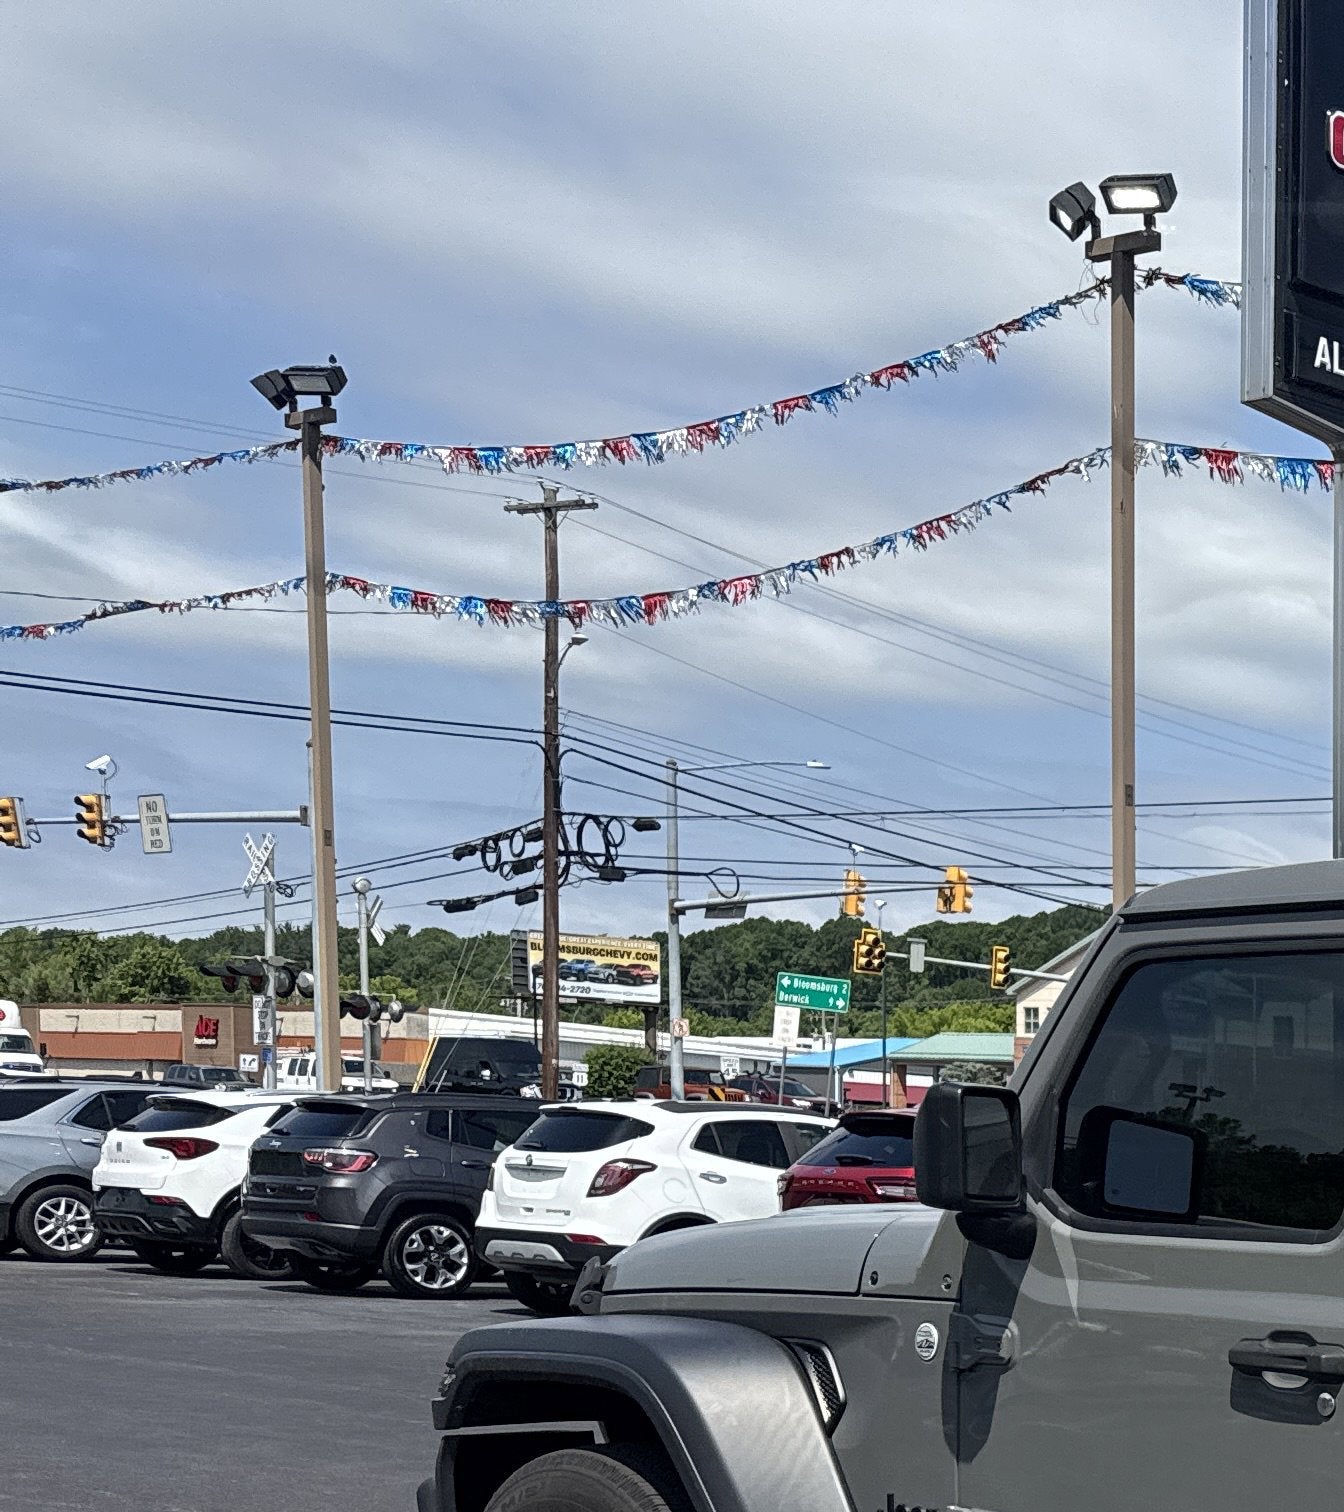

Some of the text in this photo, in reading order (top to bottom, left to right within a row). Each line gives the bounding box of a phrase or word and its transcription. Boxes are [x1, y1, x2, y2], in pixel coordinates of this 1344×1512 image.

[145, 800, 157, 813] NO
[530, 942, 658, 962] BLMSBURGCHEVY.COM
[793, 978, 848, 995] Bloomsburg 2
[779, 990, 810, 1004] Berwick
